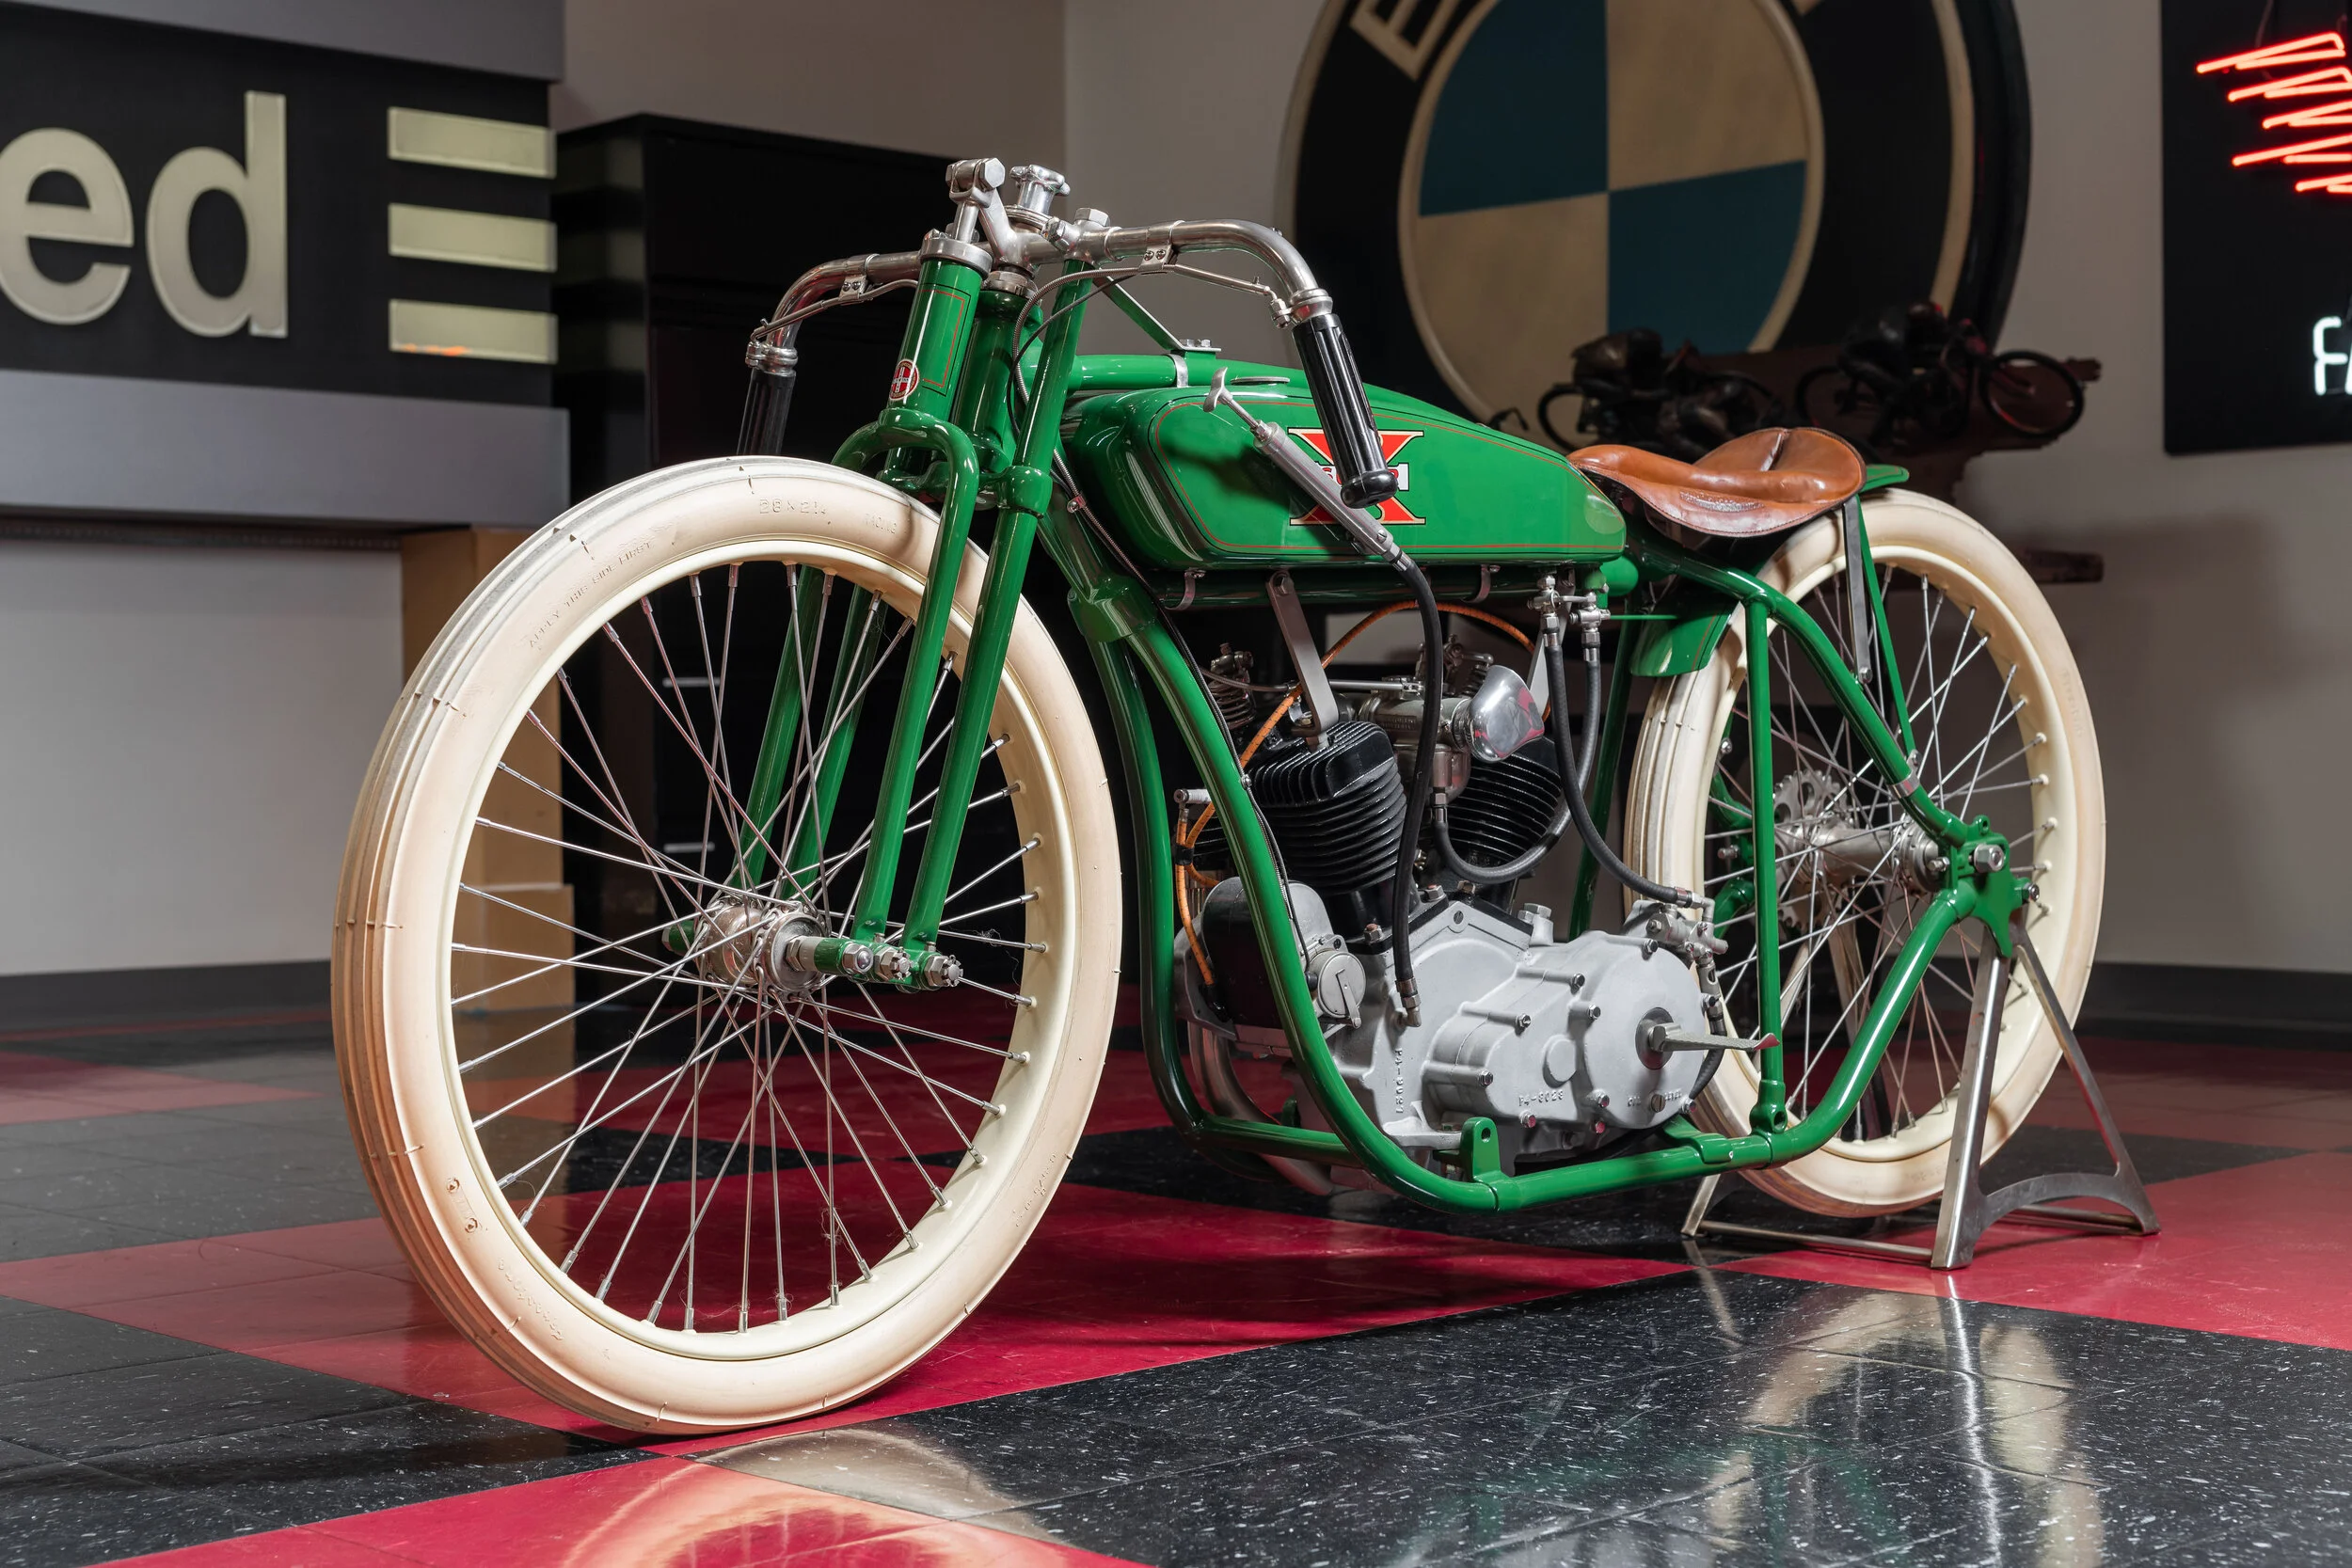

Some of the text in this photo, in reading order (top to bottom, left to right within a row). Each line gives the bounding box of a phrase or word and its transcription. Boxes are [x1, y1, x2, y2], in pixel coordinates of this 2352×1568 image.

[0, 90, 288, 338] ed
[2312, 316, 2352, 395] F
[564, 584, 589, 608] THIS
[592, 564, 615, 584] SIDE
[618, 541, 652, 565] FIRST
